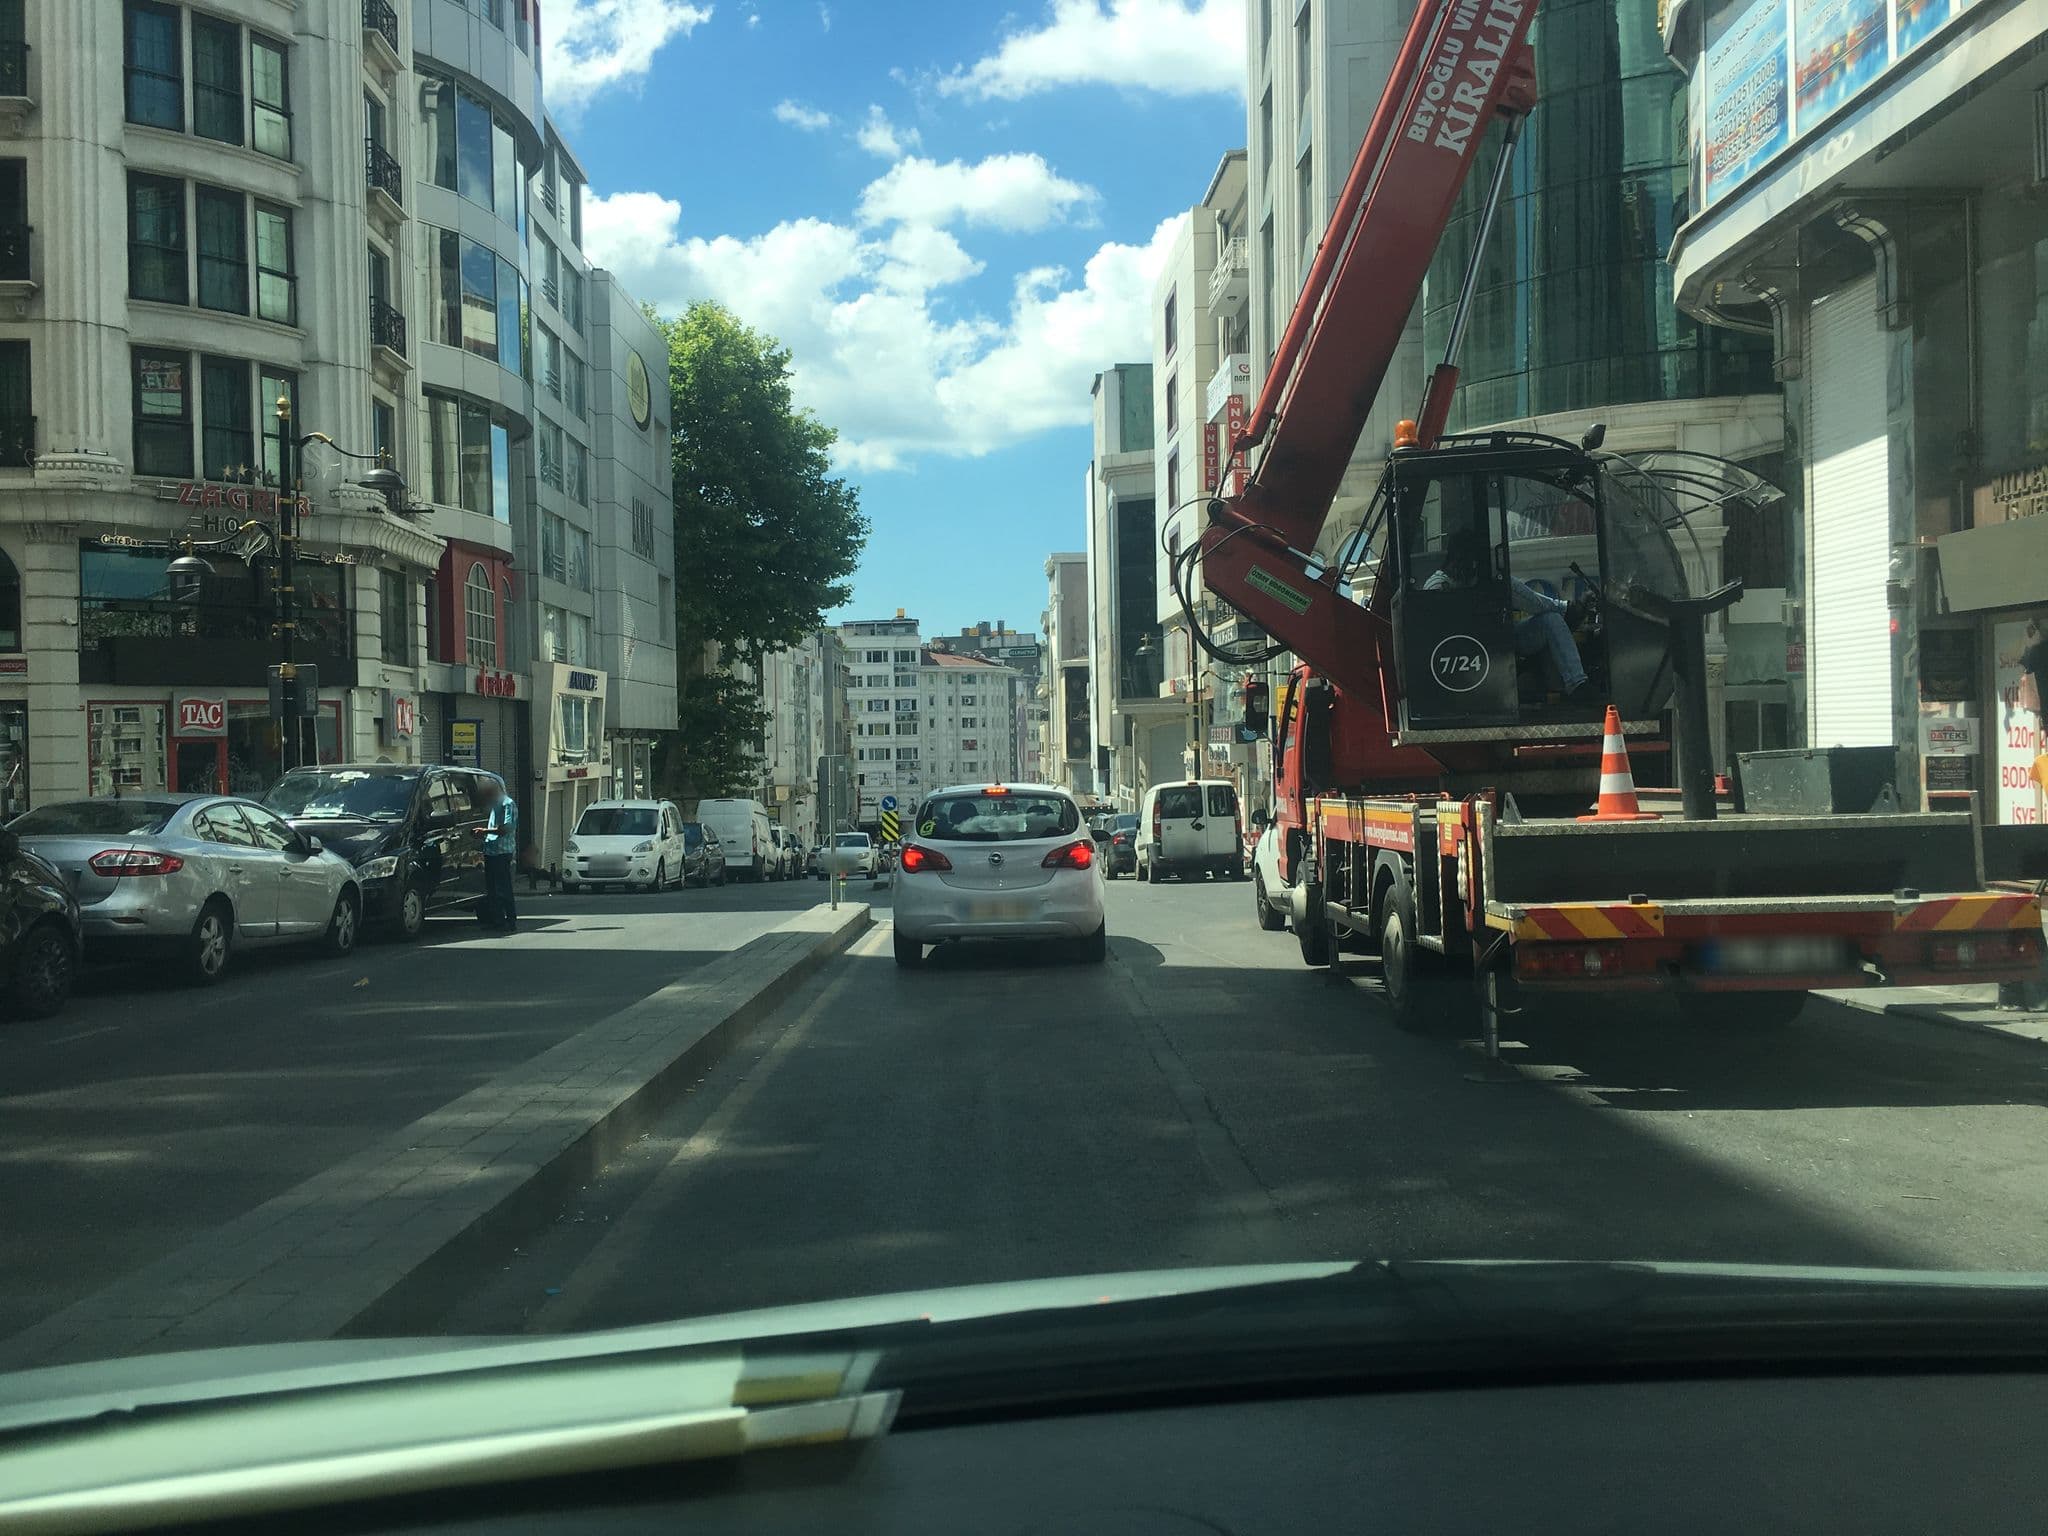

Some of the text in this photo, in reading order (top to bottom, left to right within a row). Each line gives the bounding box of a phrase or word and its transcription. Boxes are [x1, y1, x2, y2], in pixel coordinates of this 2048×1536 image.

[1407, 36, 1464, 143] BEYOĞLU
[1439, 655, 1482, 674] 7/24
[1930, 731, 1968, 742] DATEKS
